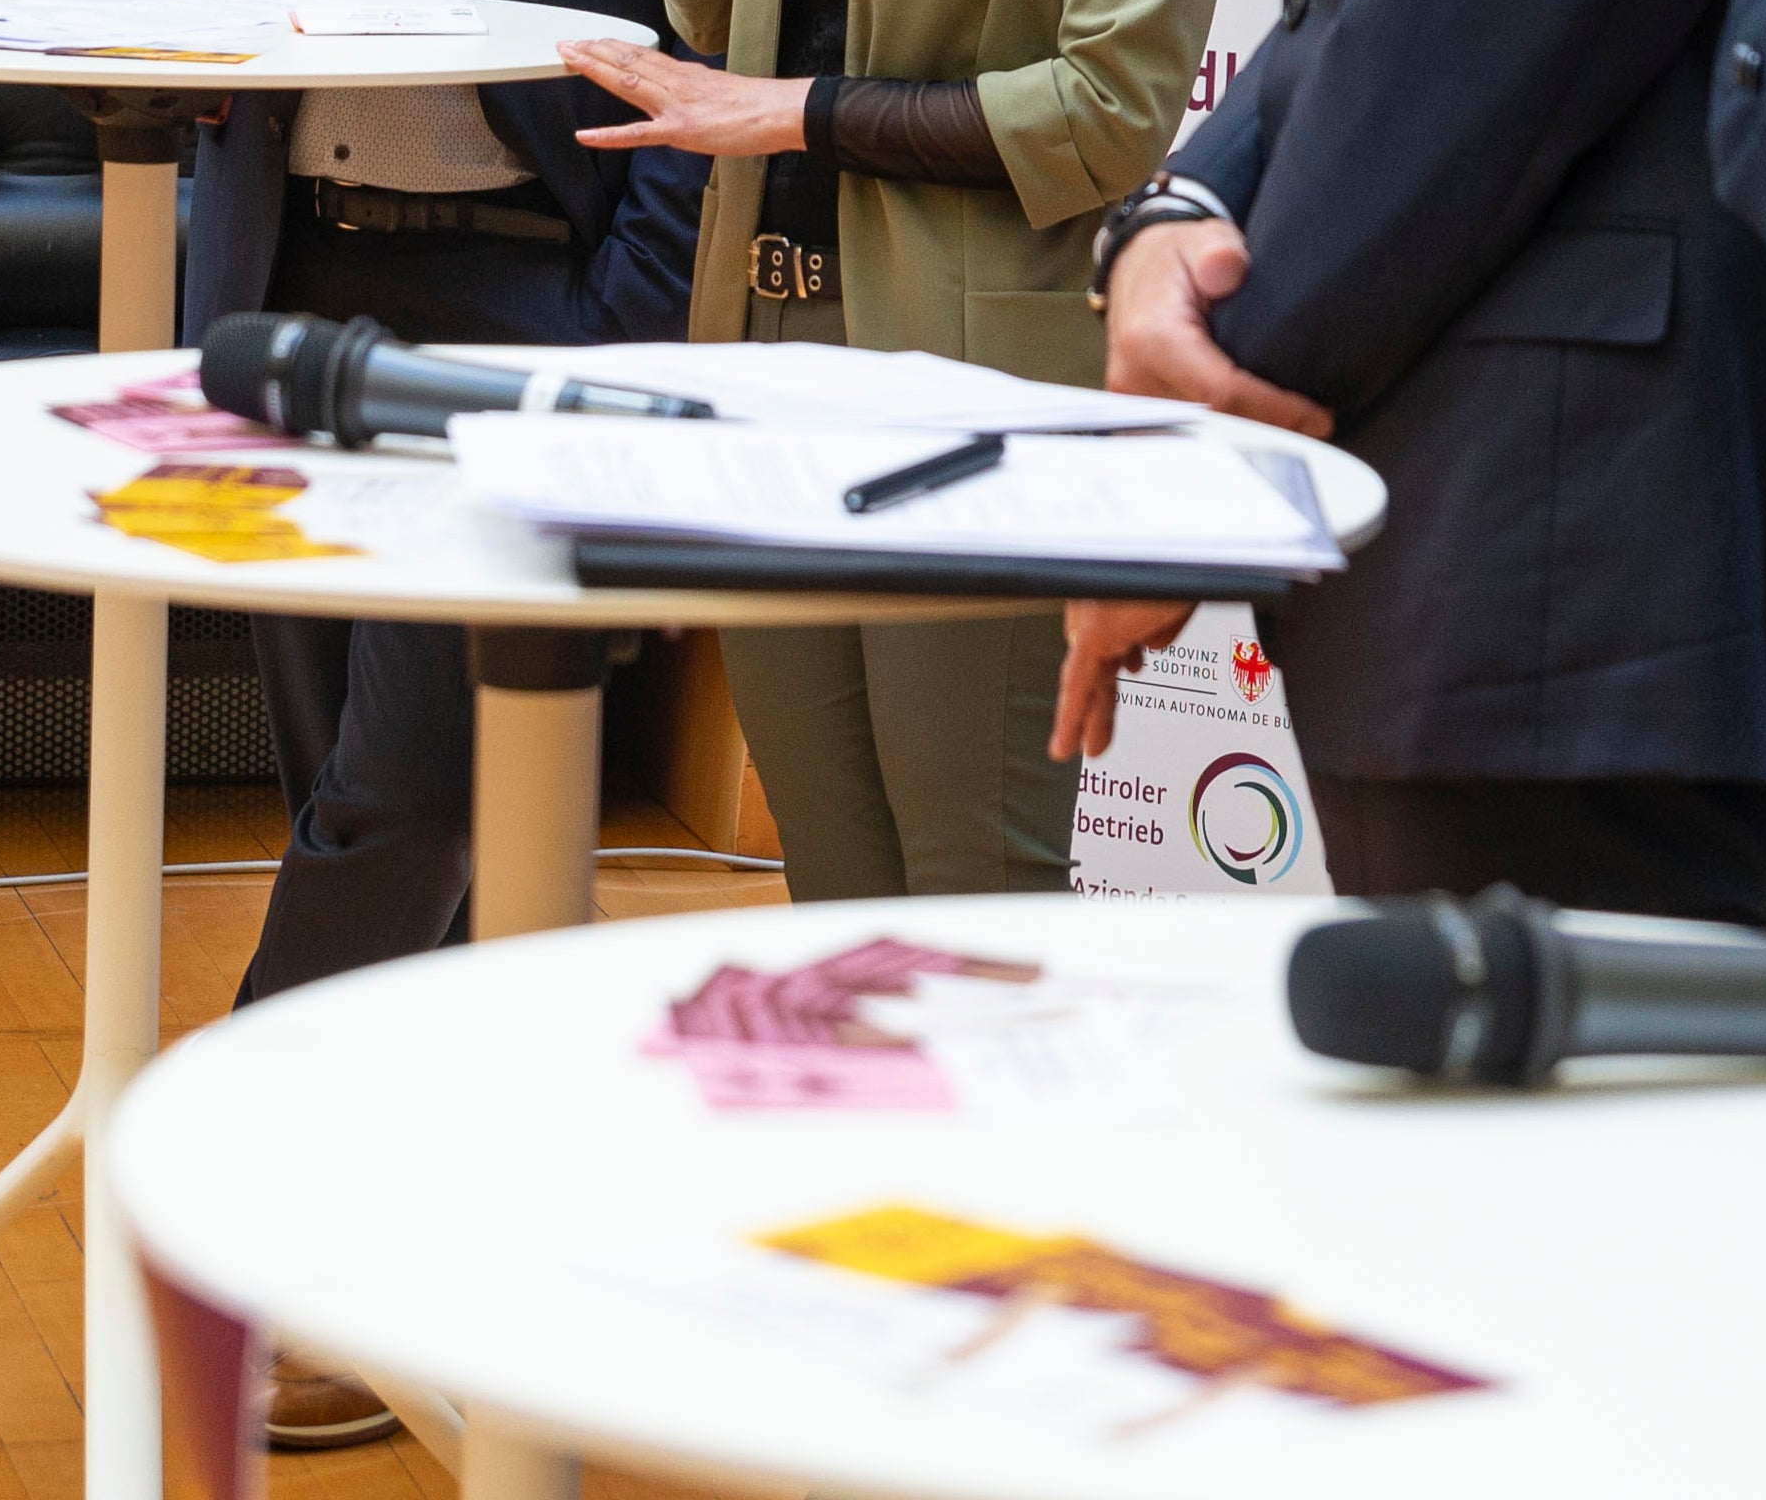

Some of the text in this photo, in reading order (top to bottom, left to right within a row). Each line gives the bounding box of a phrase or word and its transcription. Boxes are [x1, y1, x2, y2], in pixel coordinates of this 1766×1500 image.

[1153, 658, 1218, 681] SÜDTIROL
[1170, 700, 1247, 724] AUTONOMA
[1251, 711, 1269, 727] DE
[1077, 768, 1168, 805] dtiroler
